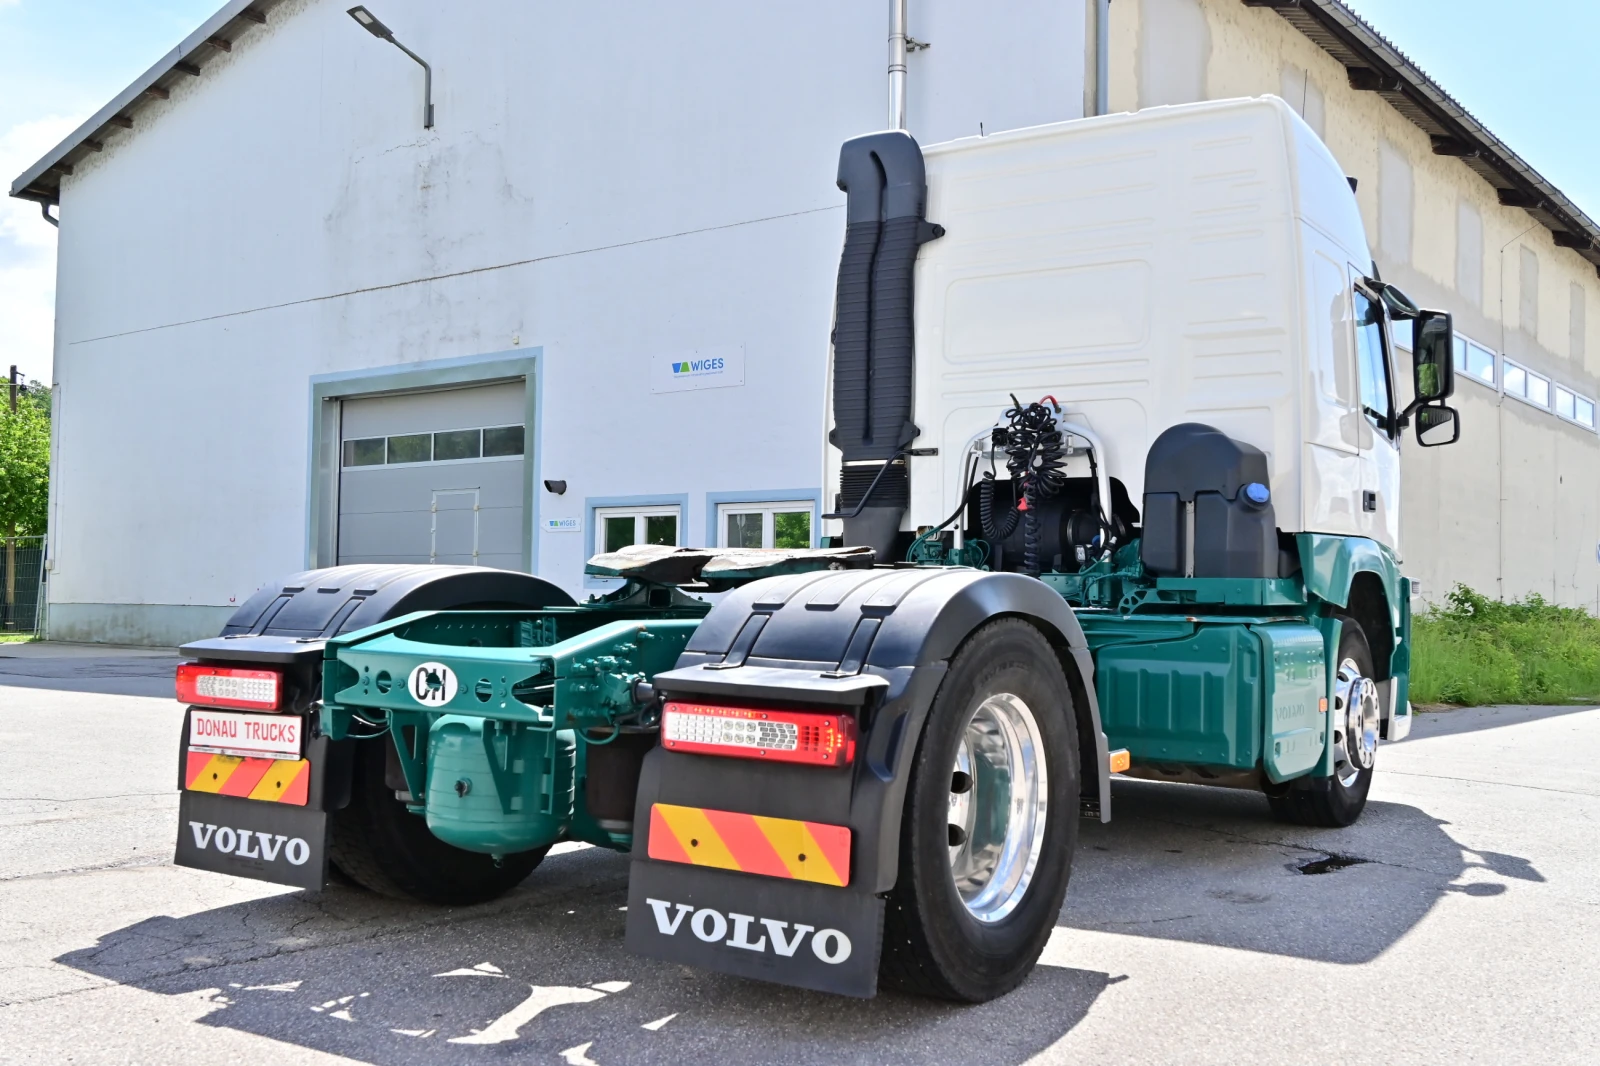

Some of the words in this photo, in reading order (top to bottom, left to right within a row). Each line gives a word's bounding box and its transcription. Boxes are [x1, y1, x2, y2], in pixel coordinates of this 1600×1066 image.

[690, 358, 724, 371] WIGES
[415, 667, 447, 701] CH
[196, 718, 237, 738] DONAU
[244, 721, 295, 743] TRUCKS
[189, 821, 310, 866] VOLVO
[646, 898, 852, 965] VOLVO
